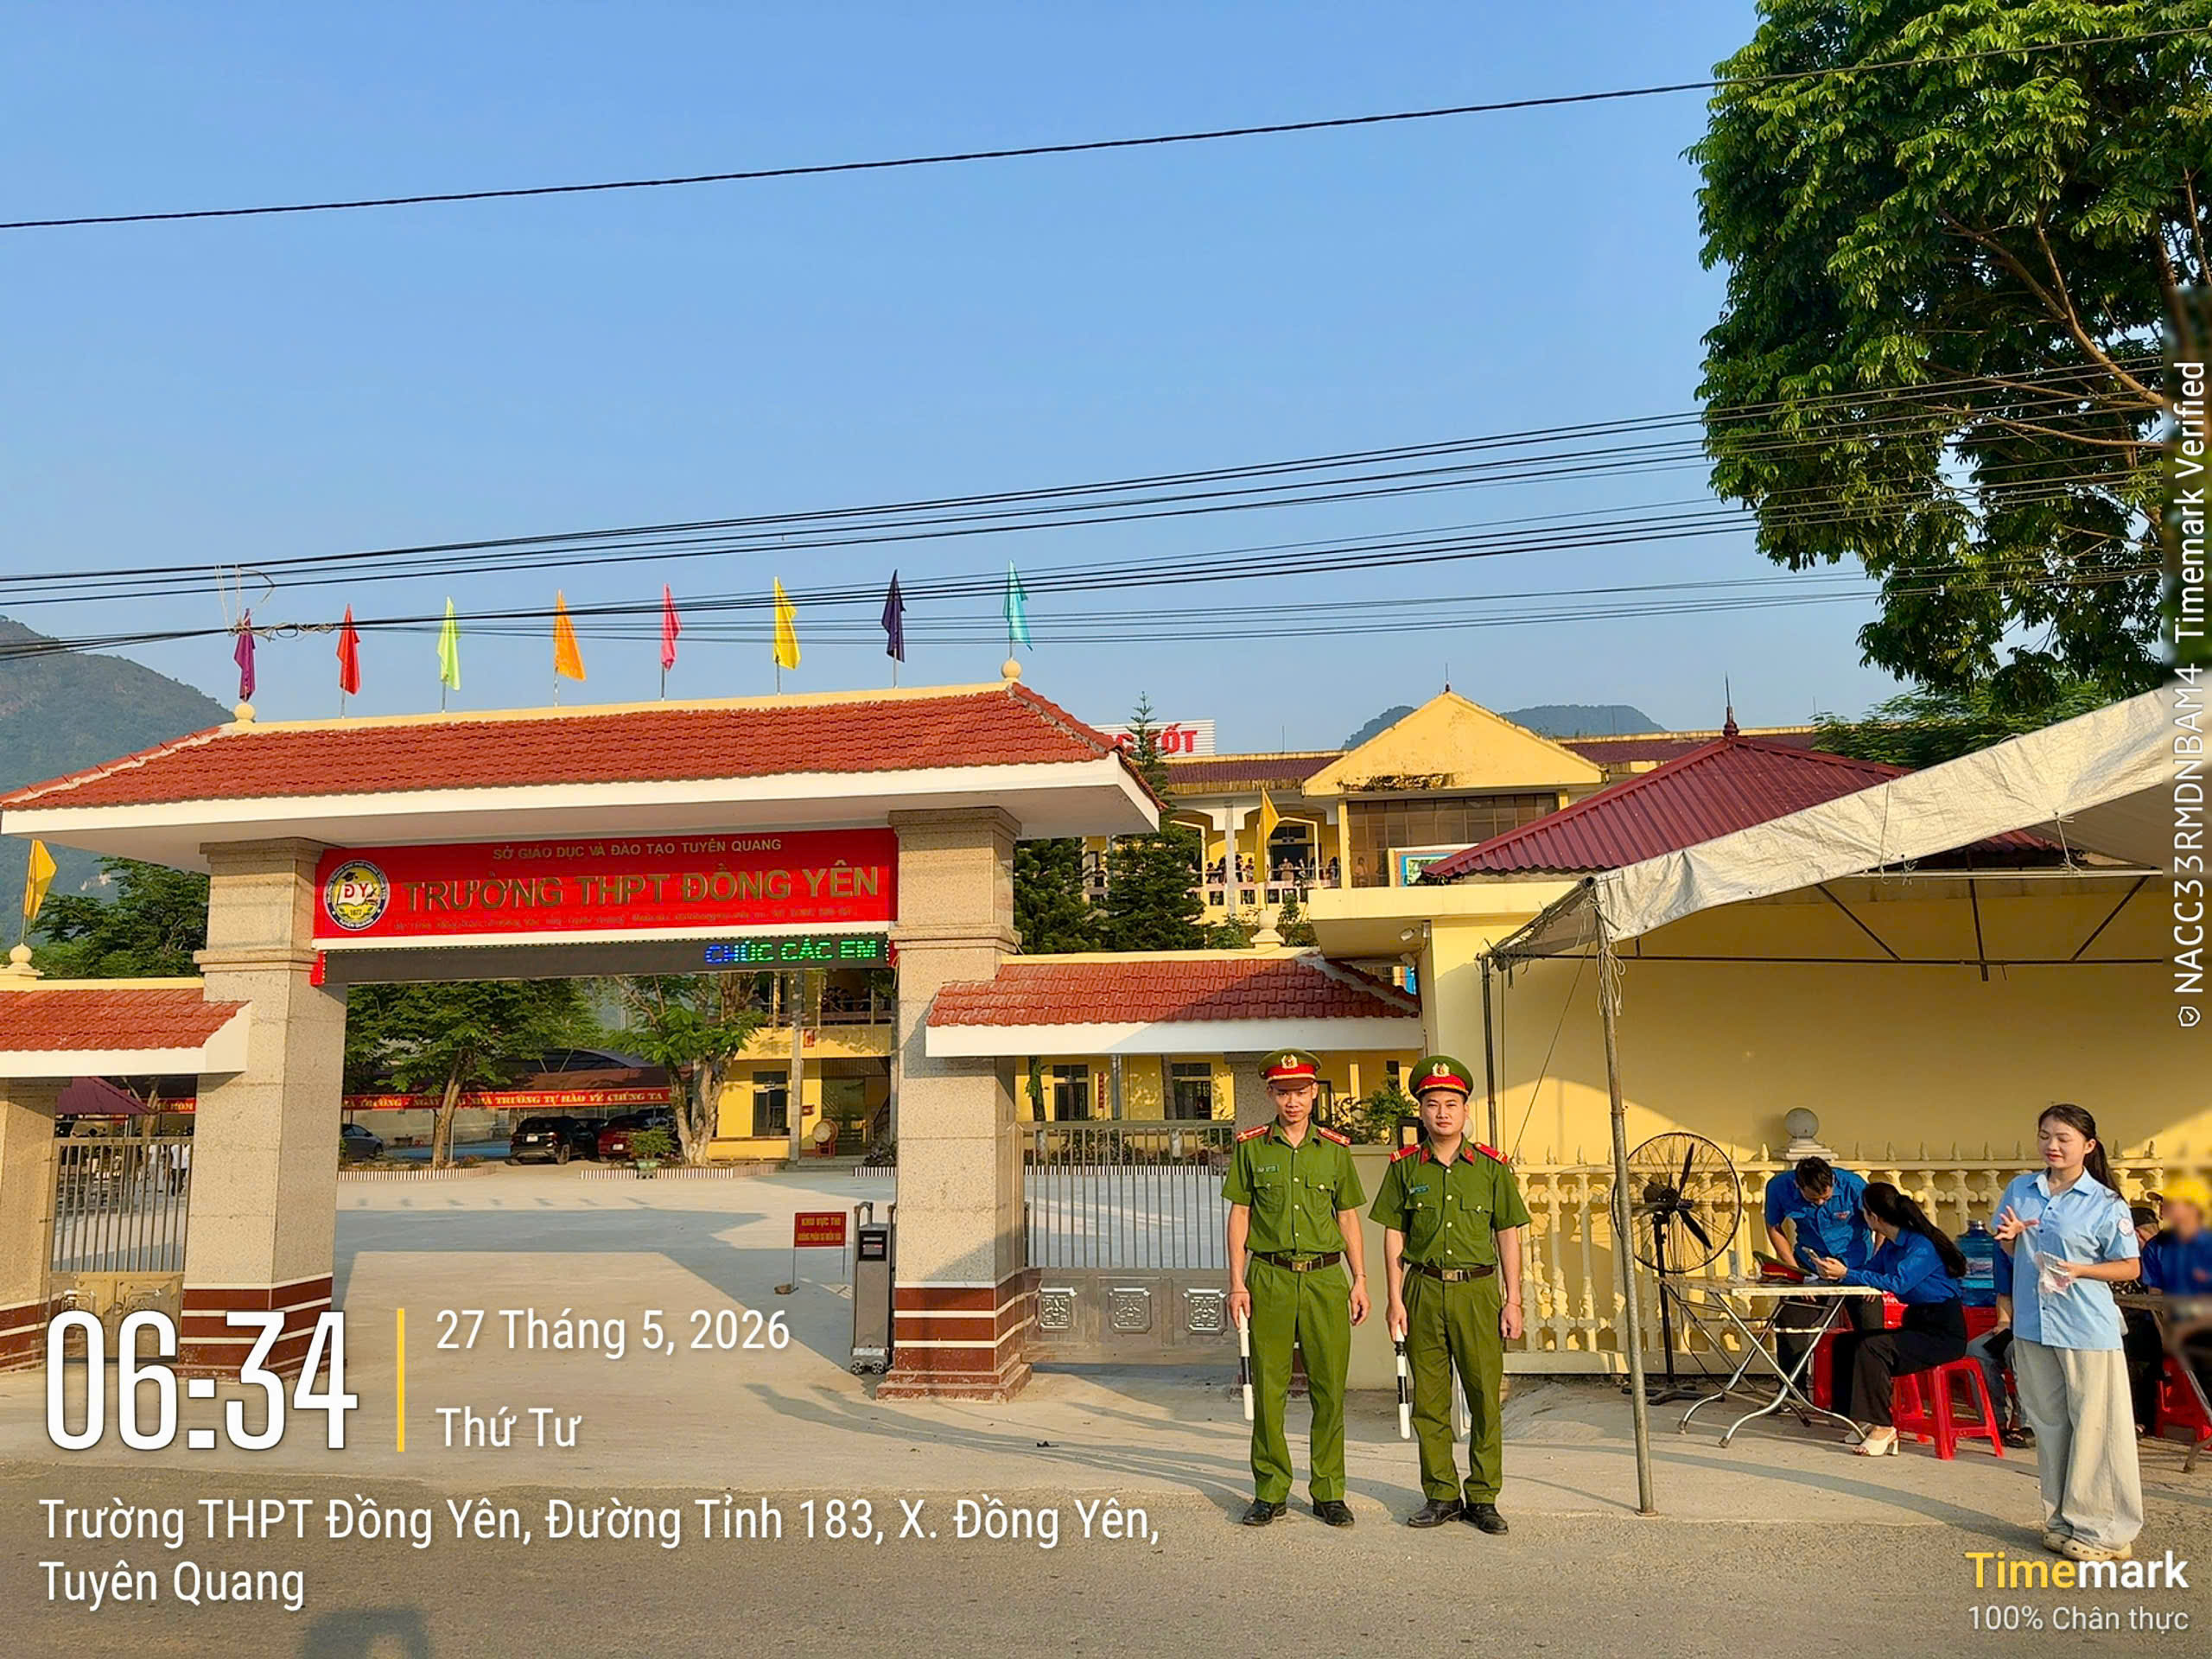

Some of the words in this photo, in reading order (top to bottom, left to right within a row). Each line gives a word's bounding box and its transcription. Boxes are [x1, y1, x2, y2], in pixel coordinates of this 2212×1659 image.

[493, 845, 514, 860] SỞ
[518, 844, 552, 859] GIÁO
[556, 846, 585, 861] DỤC
[589, 842, 605, 856] VÀ
[611, 842, 641, 856] ĐÀO
[646, 843, 676, 857] TẠO
[681, 837, 726, 854] TUYÊN
[731, 838, 782, 852] QUANG
[402, 871, 563, 912] TRƯỜNG
[574, 873, 670, 906] THPT
[681, 862, 792, 903] ĐỒNG
[801, 859, 879, 899] YÊN
[704, 938, 774, 963] CHÚC
[780, 938, 835, 961] CÁC
[839, 939, 878, 960] EM
[607, 1090, 645, 1102] CHÚNG
[648, 1090, 664, 1101] TA
